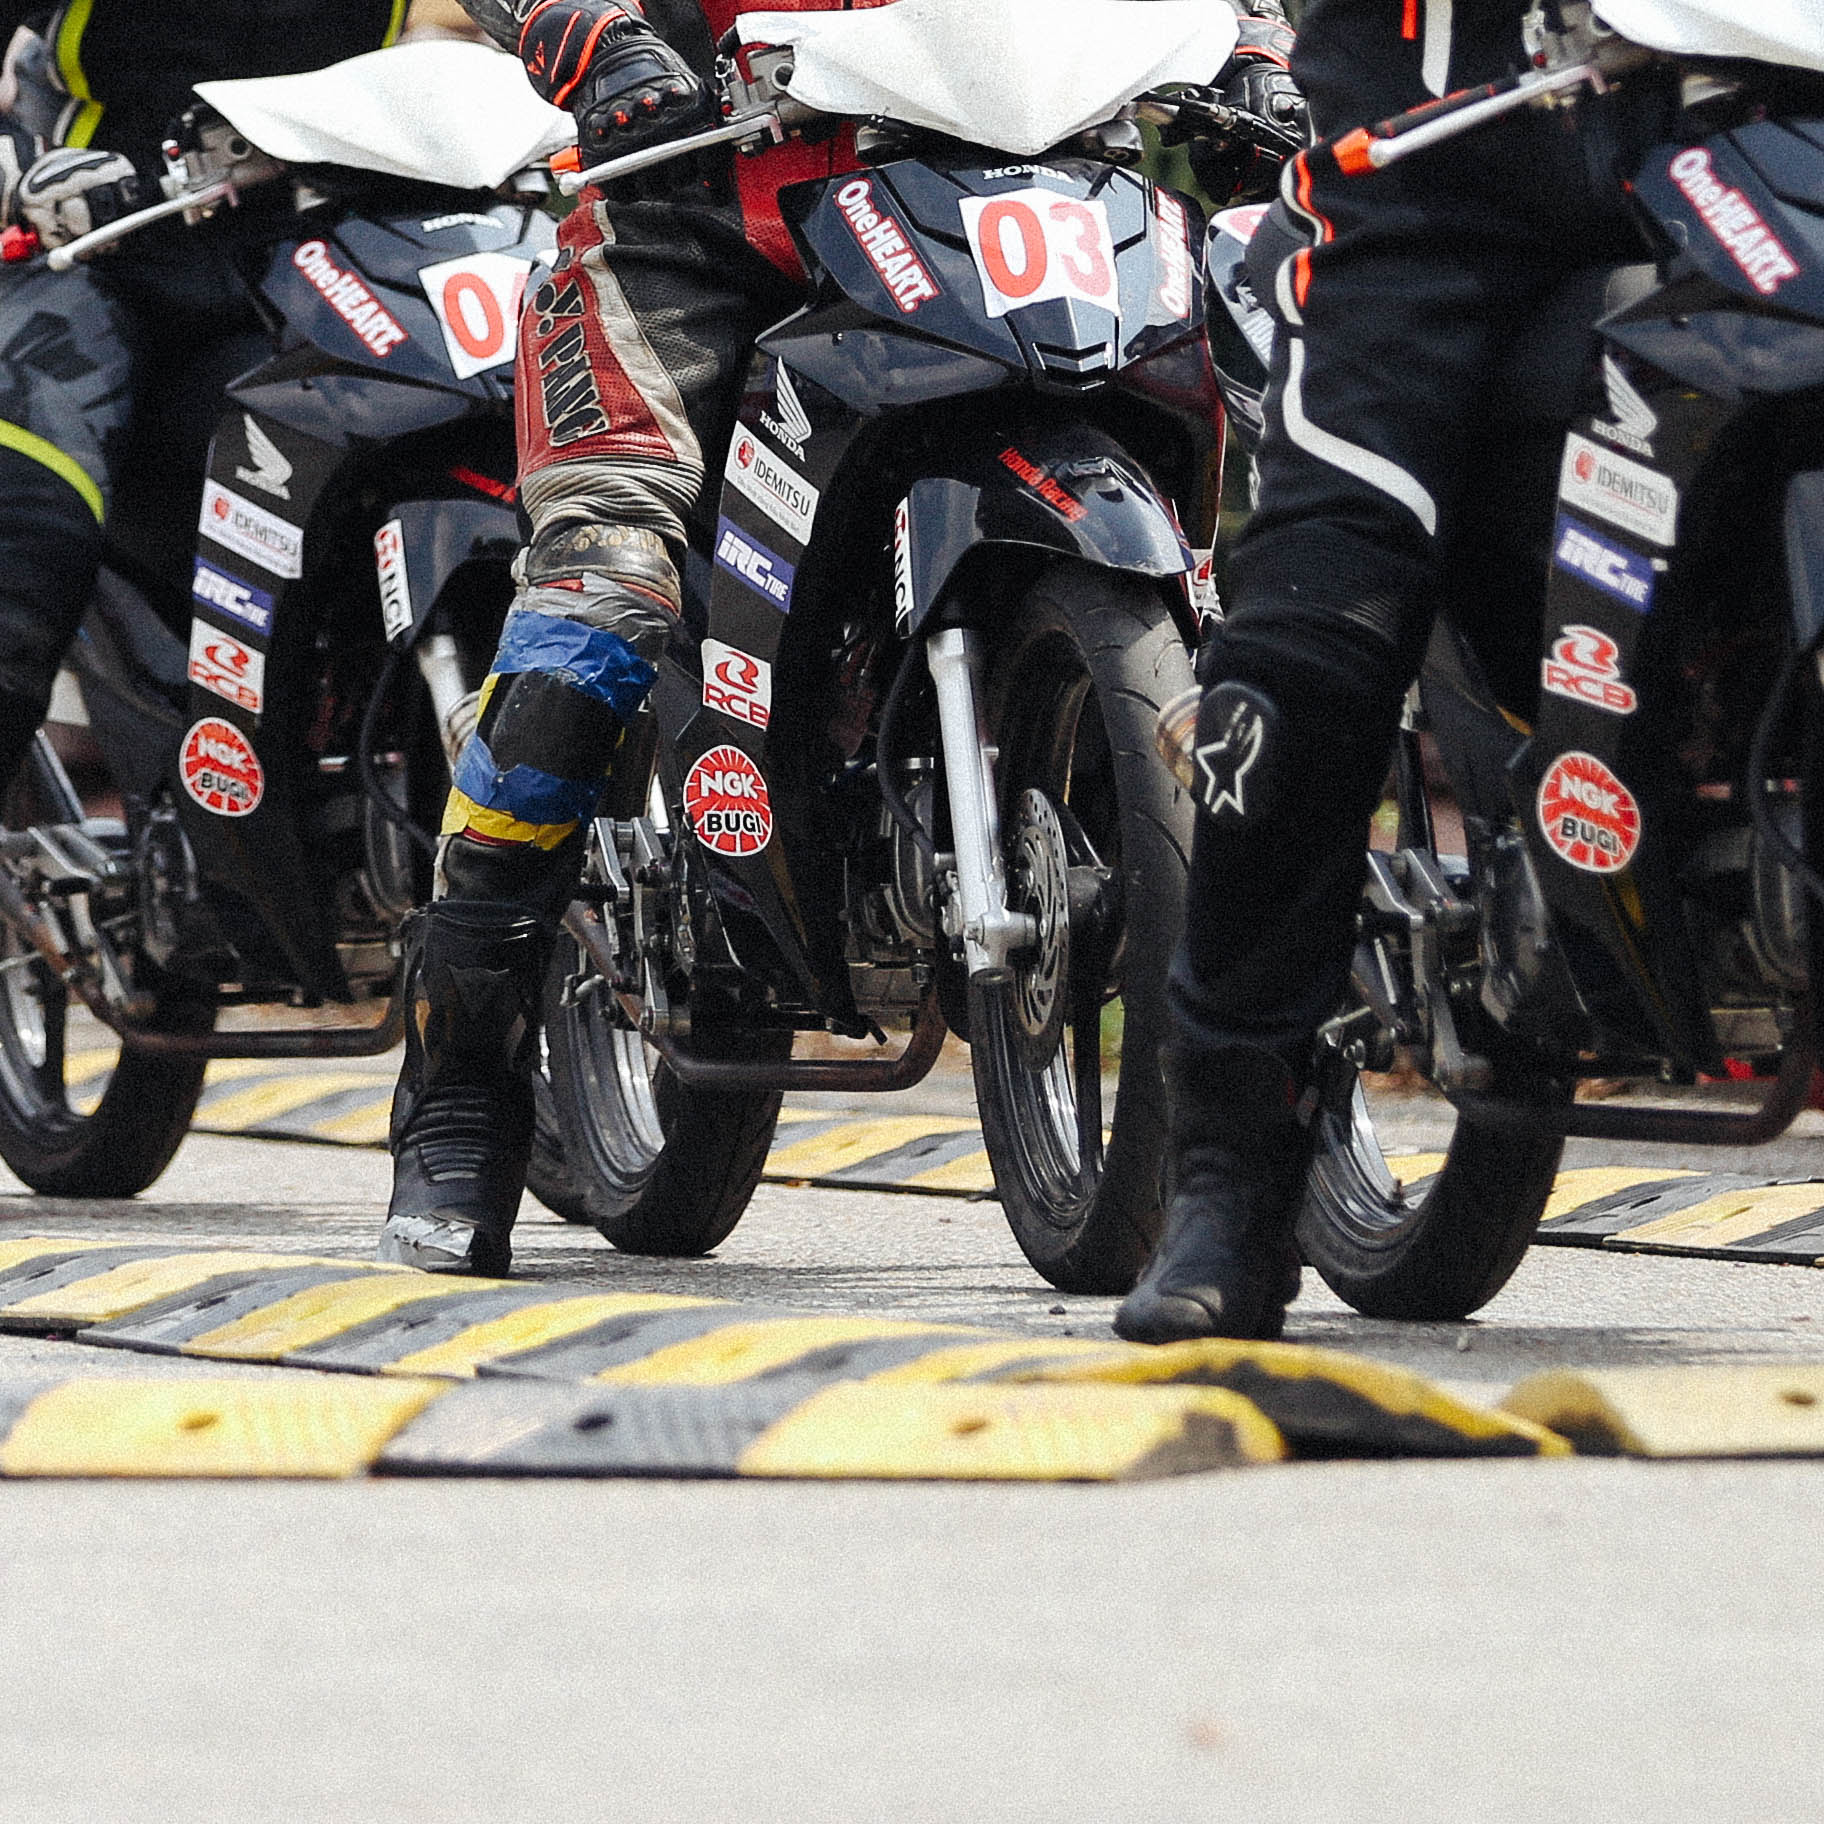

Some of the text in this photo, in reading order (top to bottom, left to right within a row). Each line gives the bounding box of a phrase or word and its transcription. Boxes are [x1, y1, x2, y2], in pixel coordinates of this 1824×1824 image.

[983, 164, 1075, 183] HONDA
[978, 199, 1112, 298] 03
[443, 272, 528, 359] 0
[759, 410, 806, 463] HONDA
[1590, 419, 1655, 458] HONDA
[753, 456, 811, 517] IDEMITSU
[1597, 465, 1669, 514] IDEMITSU
[764, 571, 789, 601] TIRE
[704, 682, 770, 726] RCB
[1546, 665, 1633, 709] RCB
[197, 735, 250, 775] NGK
[700, 770, 758, 800] NGK
[1559, 773, 1620, 818] NGK
[706, 811, 763, 834] BUGI
[1561, 815, 1619, 856] BUGI
